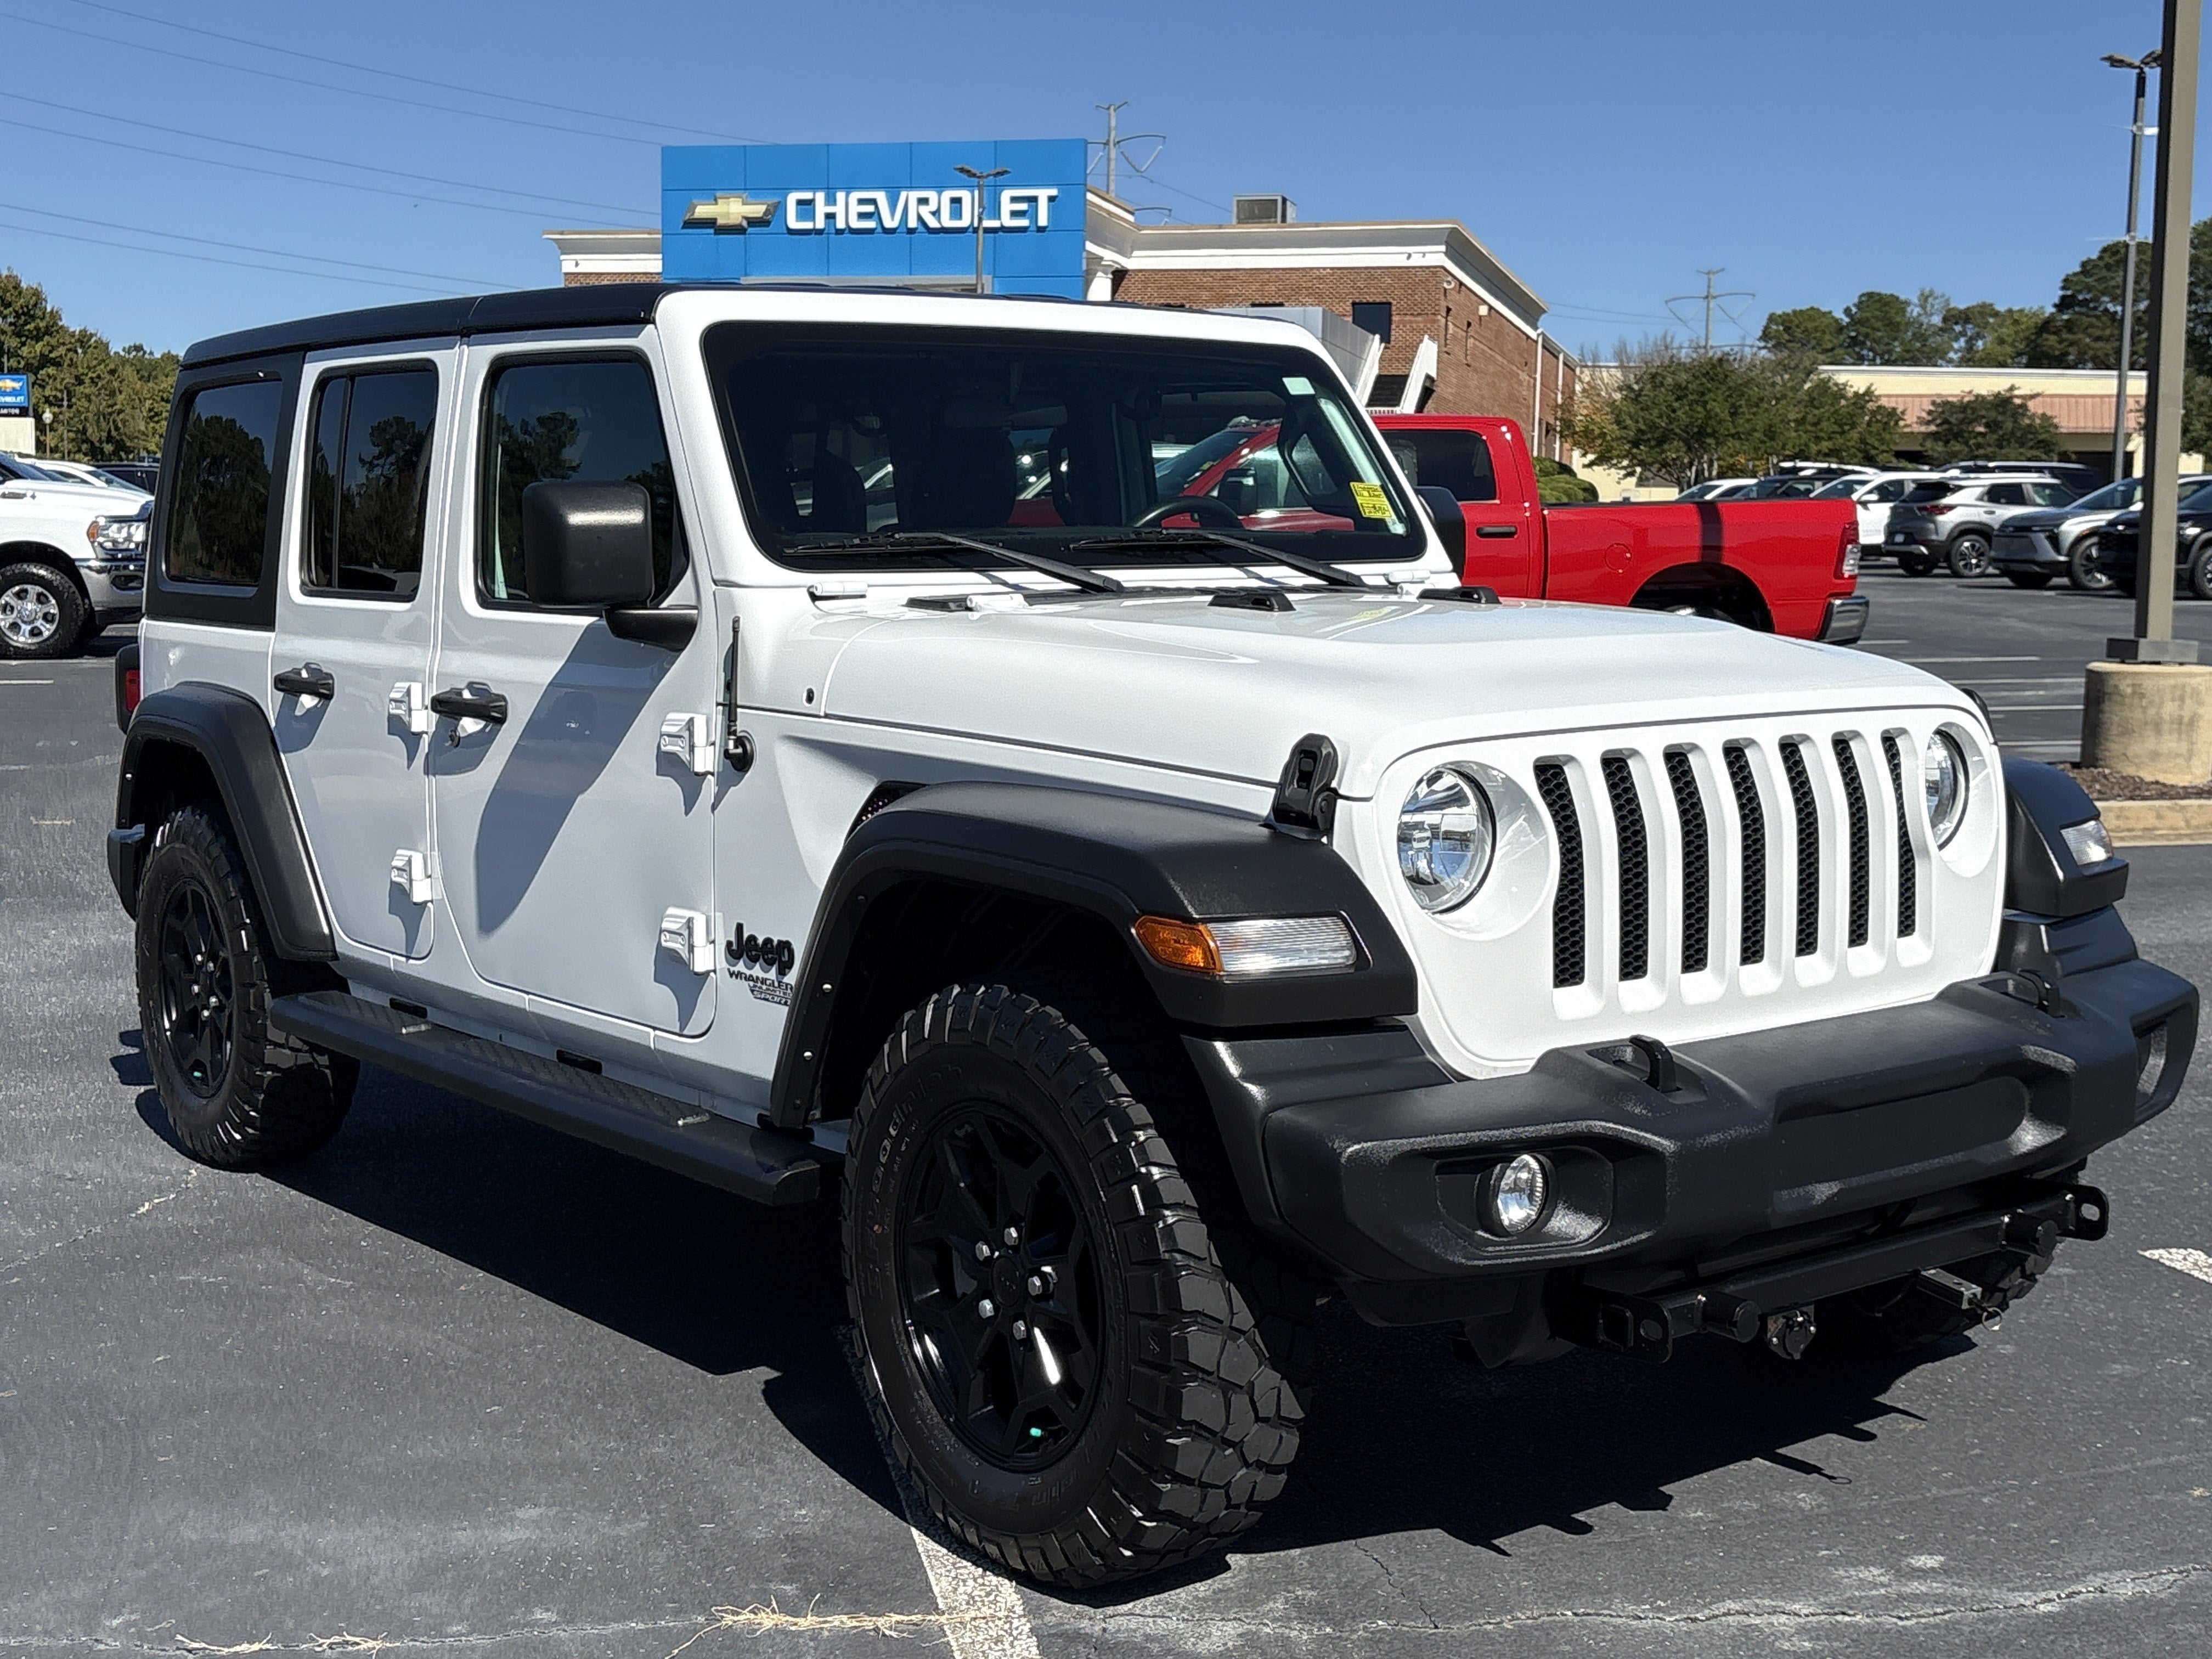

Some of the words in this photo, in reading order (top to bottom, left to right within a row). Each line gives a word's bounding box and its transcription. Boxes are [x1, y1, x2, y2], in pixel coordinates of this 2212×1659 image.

[786, 188, 1059, 230] CHEVROLET
[725, 922, 795, 977] Jeep
[727, 967, 794, 992] WRANGLER
